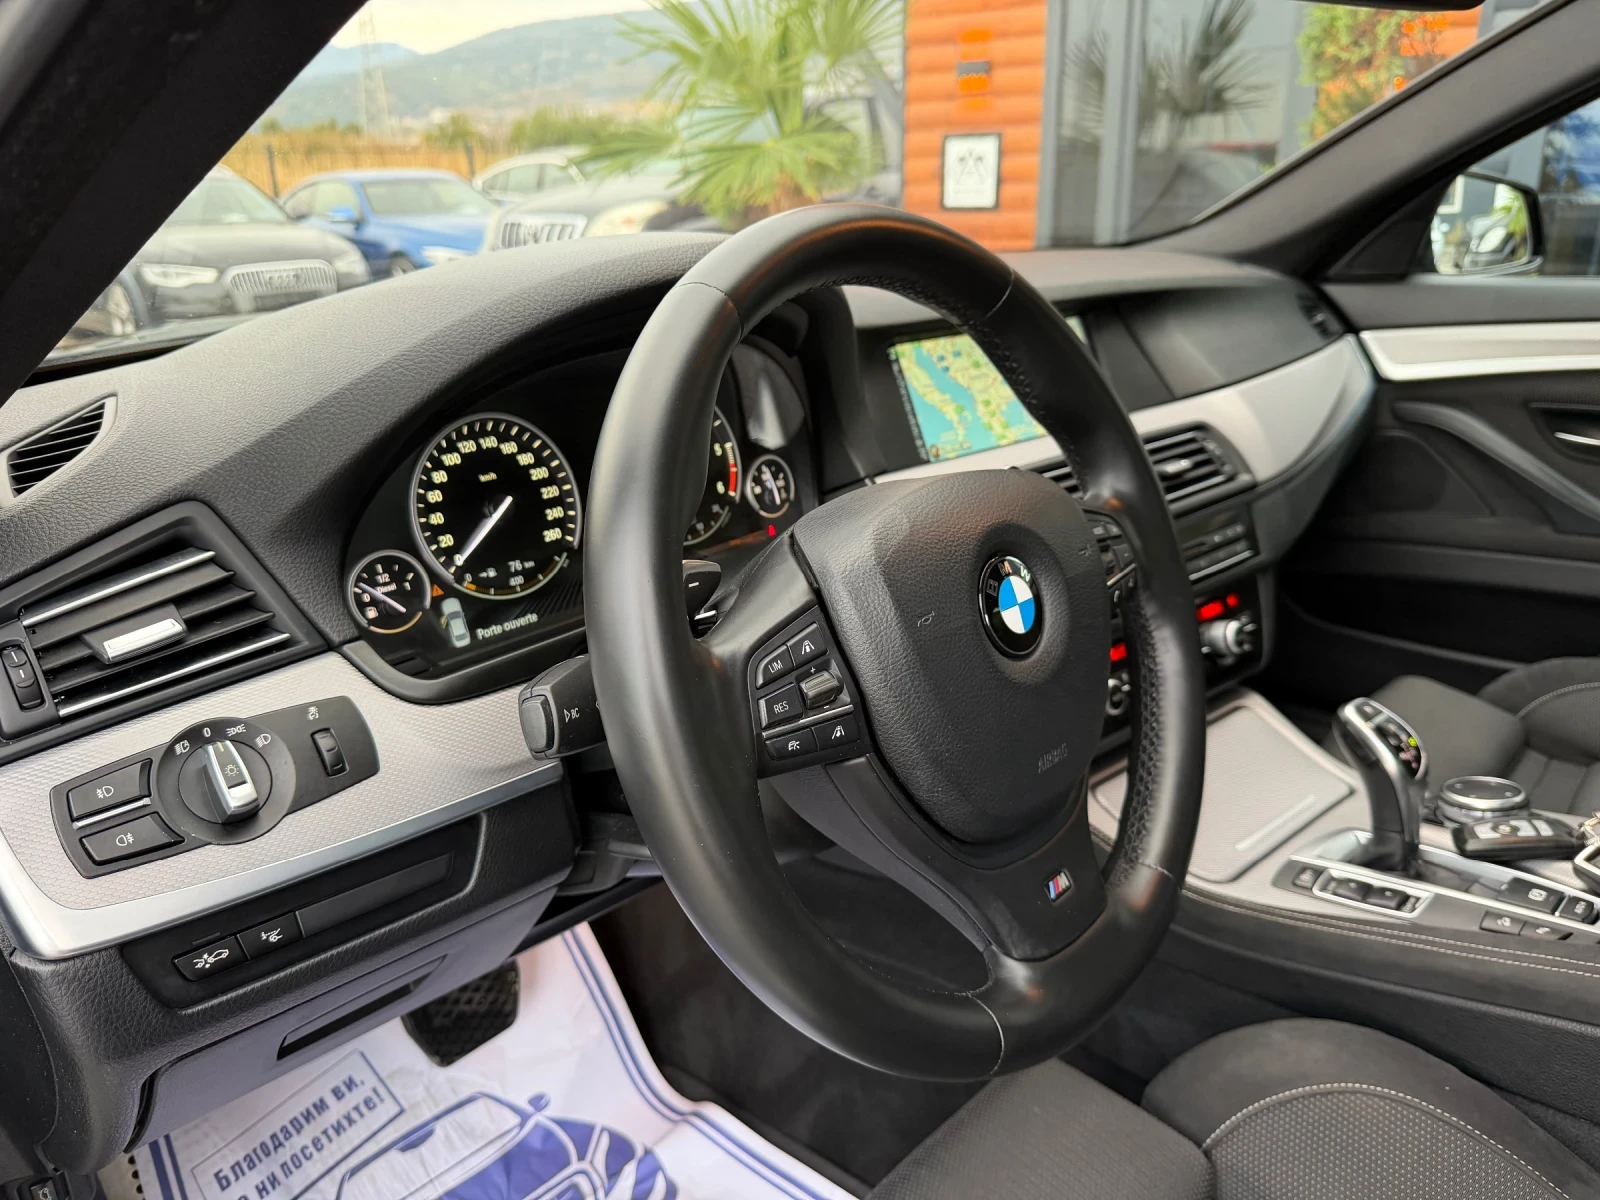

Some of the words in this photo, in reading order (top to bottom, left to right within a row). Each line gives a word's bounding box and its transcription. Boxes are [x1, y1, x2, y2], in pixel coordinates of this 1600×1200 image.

[456, 440, 477, 454] 120
[478, 436, 498, 450] 140
[499, 441, 518, 455] 160
[440, 452, 462, 467] 100
[516, 452, 535, 466] 180
[431, 470, 448, 484] 80
[478, 471, 498, 483] km/h
[529, 466, 549, 481] 200
[426, 489, 443, 503] 60
[540, 485, 560, 500] 220
[428, 512, 445, 526] 40
[545, 506, 564, 521] 240
[437, 533, 454, 548] 20
[542, 527, 562, 543] 260
[453, 553, 463, 567] 0
[508, 559, 523, 573] 76
[375, 573, 391, 584] 1/2
[464, 573, 472, 583] 0
[508, 574, 525, 587] 400
[375, 582, 397, 594] Diesel
[360, 592, 371, 603] 0
[476, 623, 503, 640] Porte
[503, 613, 539, 632] ouverte
[768, 659, 784, 674] LIM
[570, 707, 580, 719] BC
[773, 700, 789, 715] RES
[213, 1096, 331, 1192] Благодарим
[331, 1074, 366, 1102] ви,
[254, 1171, 281, 1200] ни
[280, 1086, 386, 1180] посетихте!
